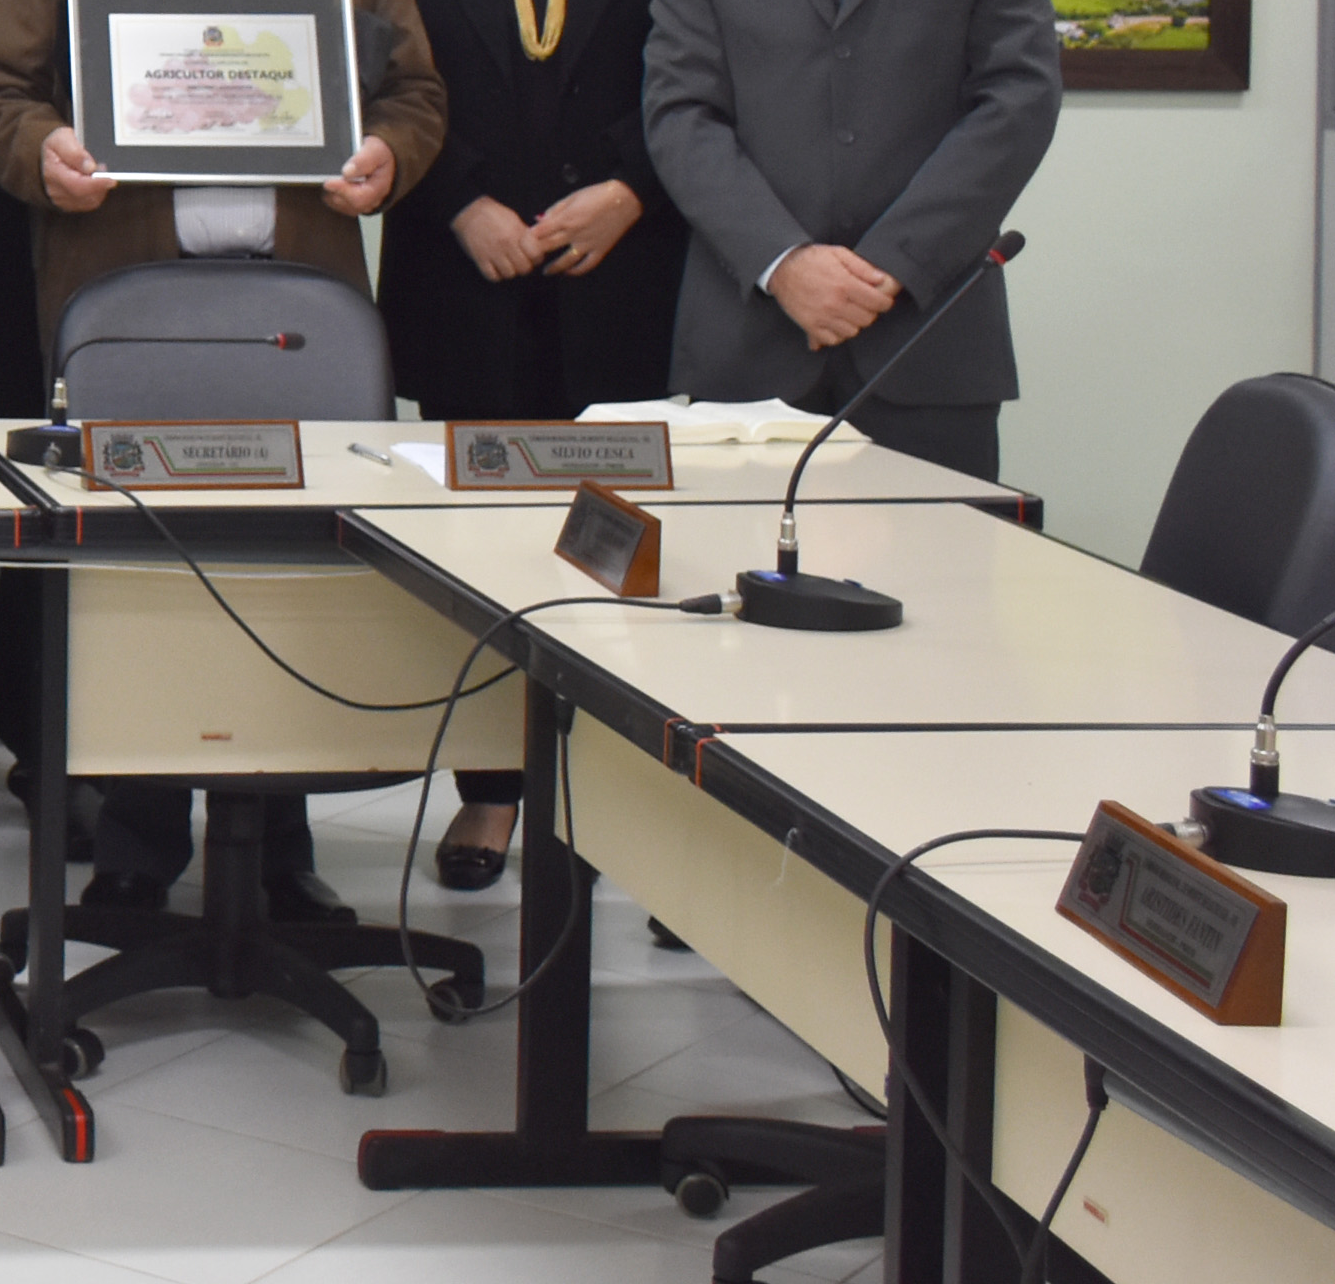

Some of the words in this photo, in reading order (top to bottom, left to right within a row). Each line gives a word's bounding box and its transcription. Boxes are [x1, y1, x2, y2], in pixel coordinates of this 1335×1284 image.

[145, 70, 224, 80] AGRICULTOR
[228, 69, 294, 81] DESTAQUE
[552, 446, 592, 459] SILVIO
[596, 447, 634, 459] CESCA
